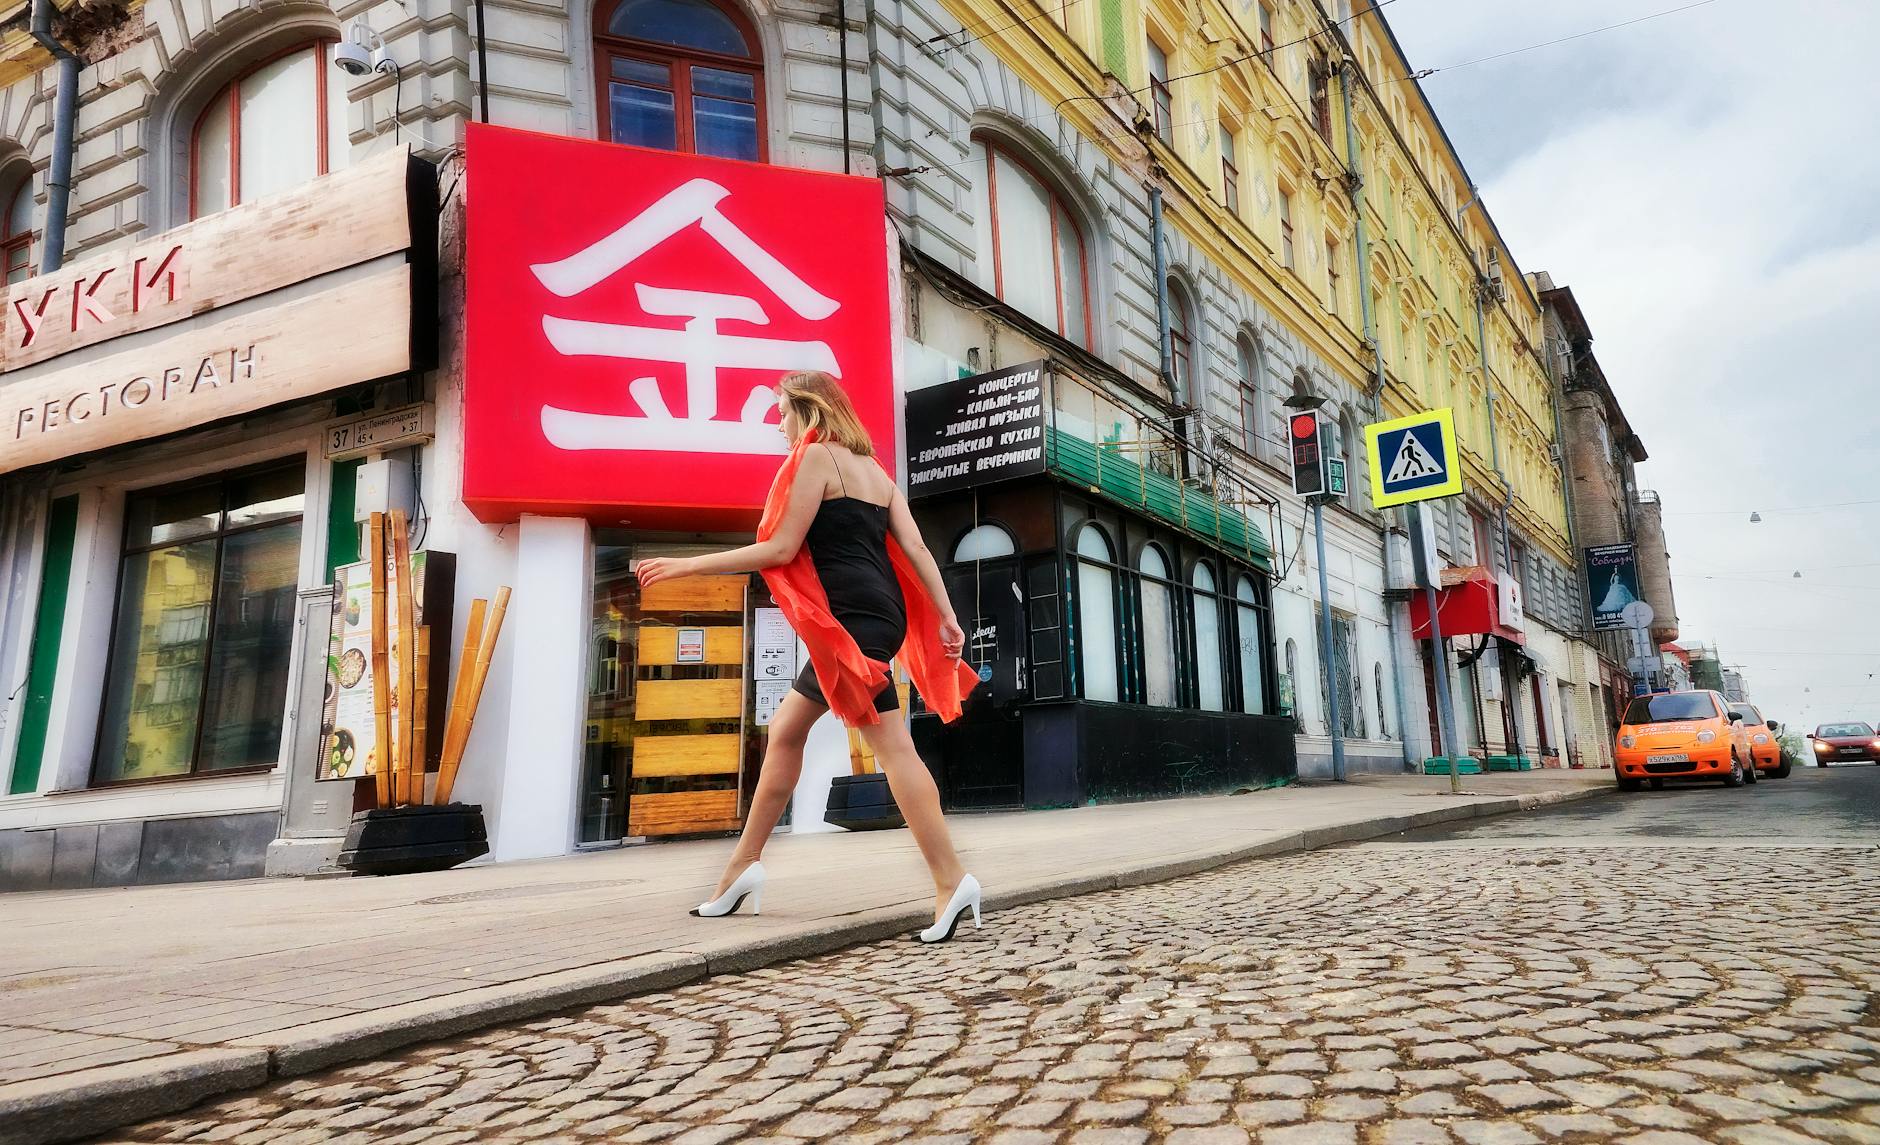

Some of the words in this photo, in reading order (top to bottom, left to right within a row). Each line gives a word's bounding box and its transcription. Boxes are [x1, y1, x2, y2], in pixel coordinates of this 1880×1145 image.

[529, 178, 842, 455] 金
[16, 344, 256, 439] РЕСТОРАН
[977, 369, 1039, 396] КОНЦЕРТЫ
[966, 386, 1040, 415] КАЛЬЯН-БАР
[409, 421, 418, 432] 37
[945, 417, 986, 437] ЖИВАЯ
[988, 405, 1040, 427] МУЗЫКА
[333, 428, 349, 449] 37
[357, 434, 367, 445] 45
[919, 436, 993, 463] ЕВРОПЕЙСКАЯ
[1000, 426, 1041, 446] КУХНЯ
[910, 461, 970, 486] ЗАКРЫТЫЕ
[976, 446, 1041, 472] ВЕЧЕРИНКИ
